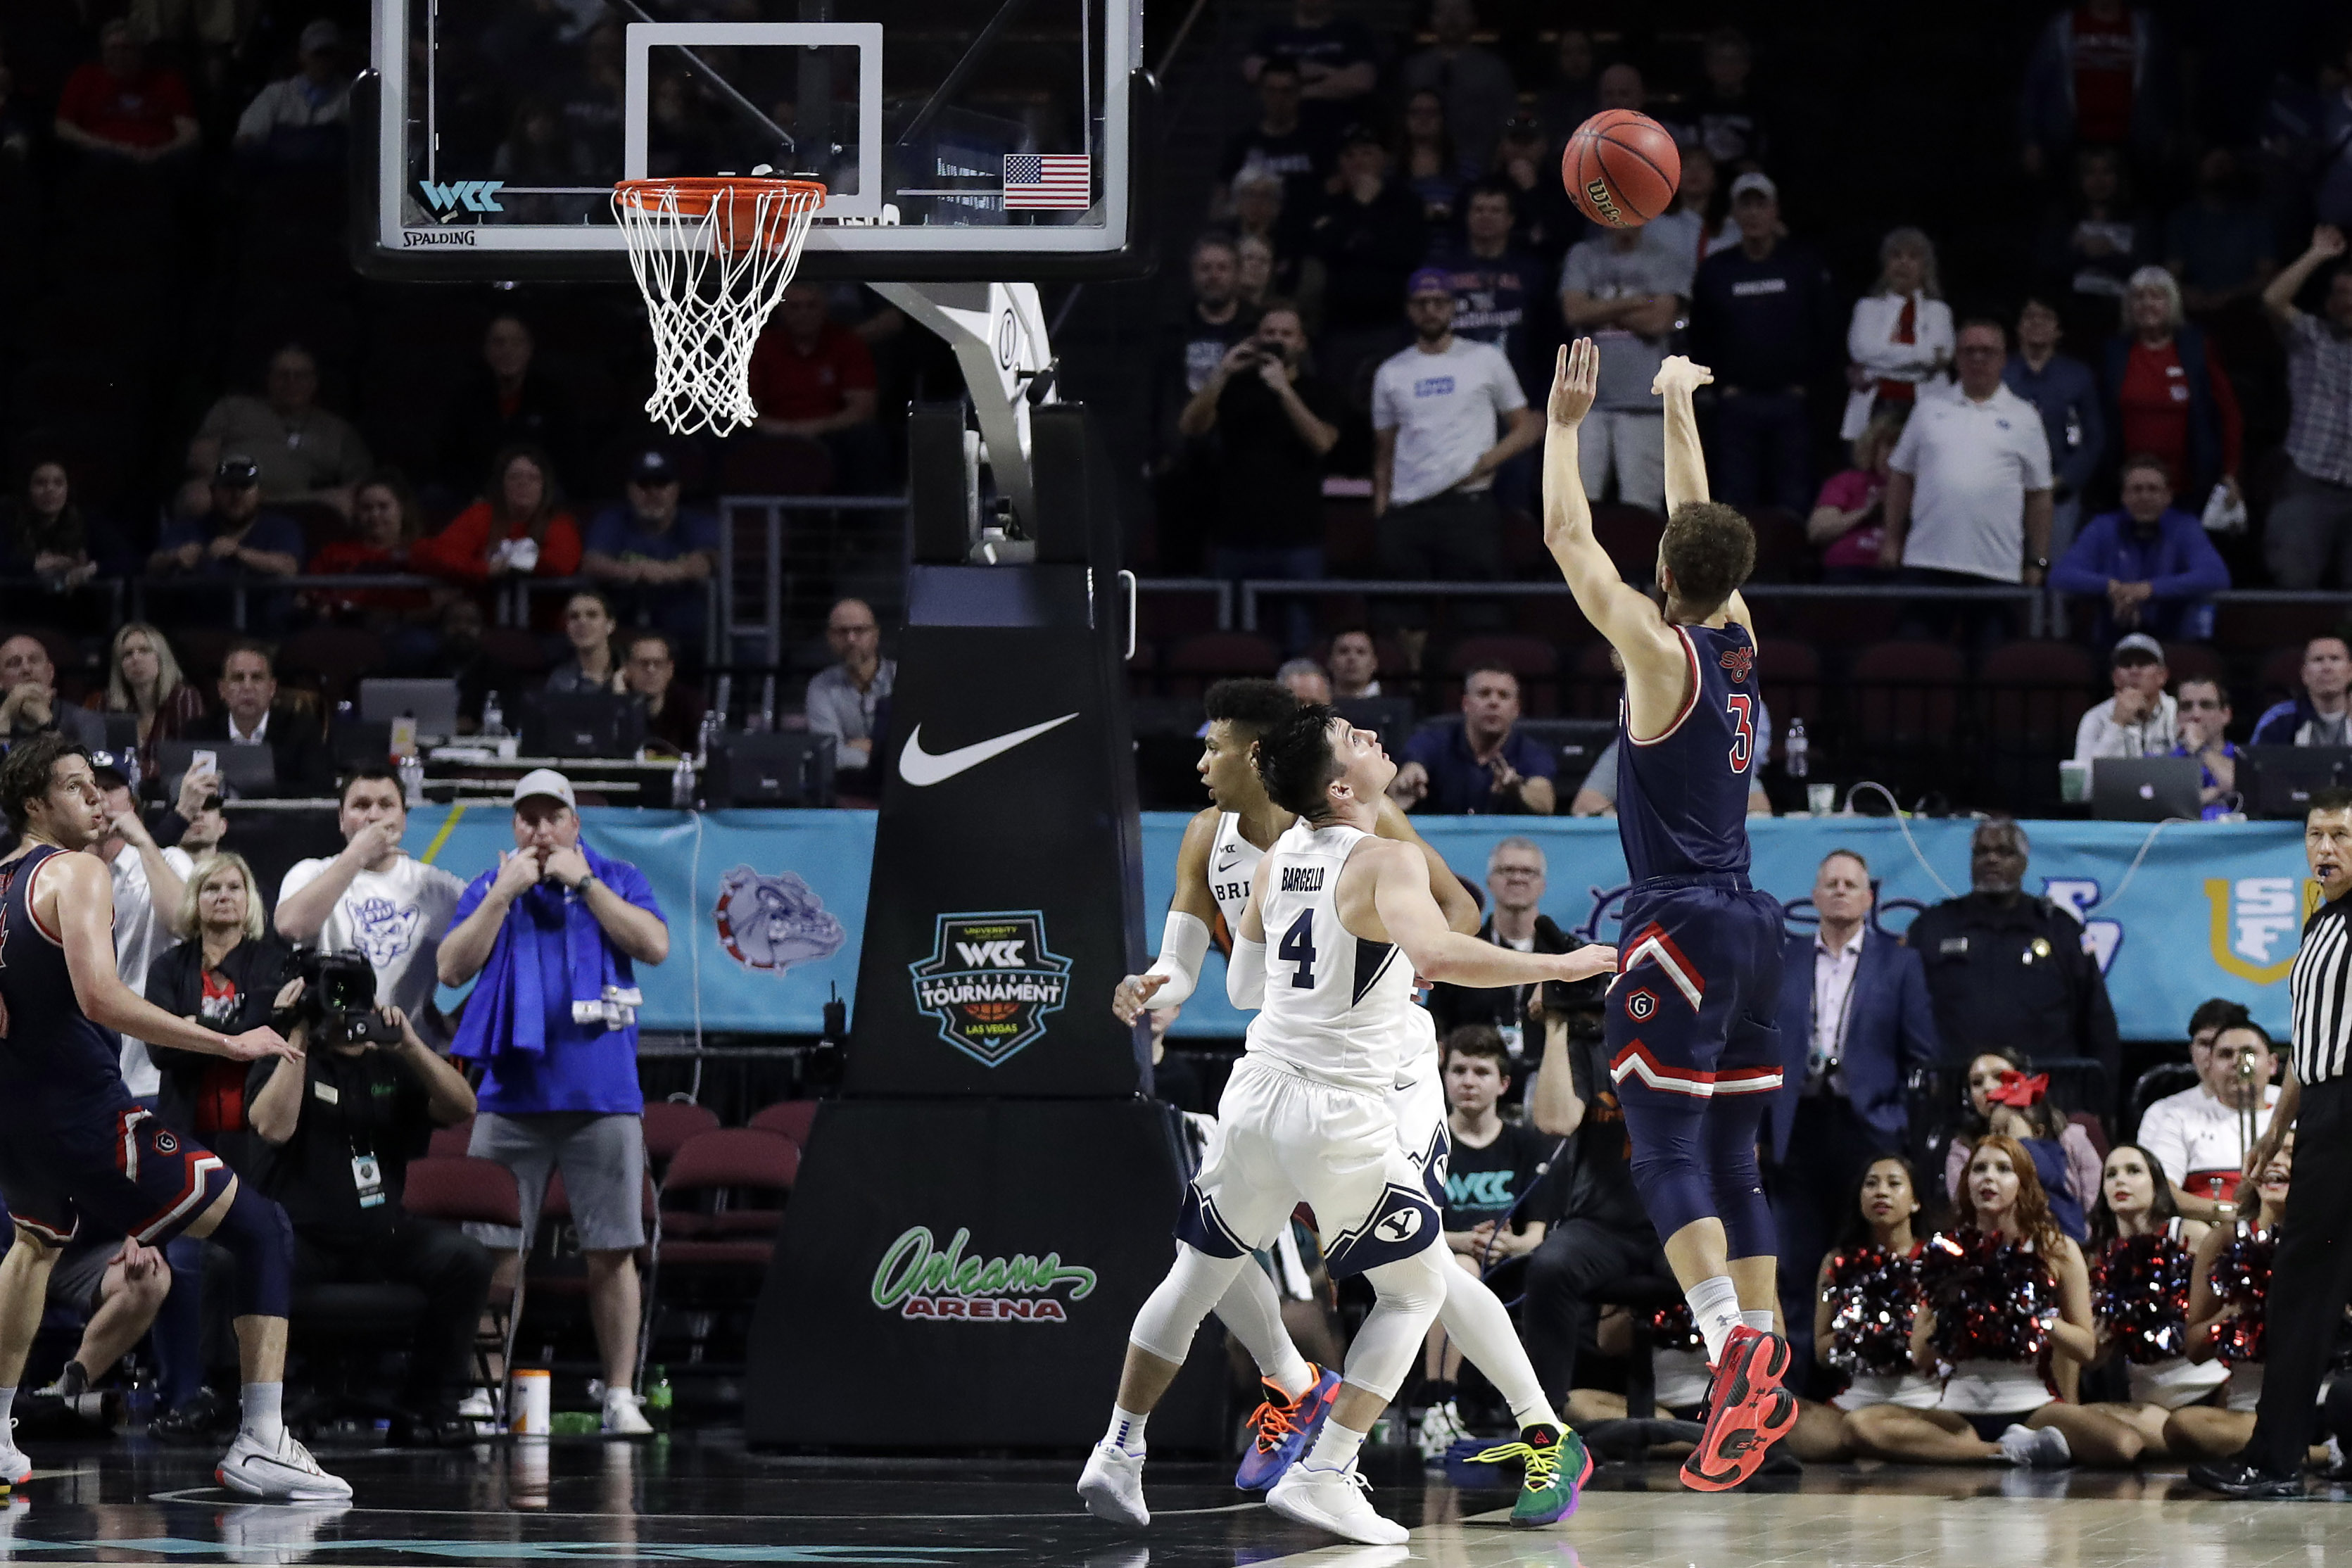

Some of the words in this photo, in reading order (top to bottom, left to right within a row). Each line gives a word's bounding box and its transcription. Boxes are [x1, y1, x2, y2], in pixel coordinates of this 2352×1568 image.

[419, 181, 505, 211] WCC
[403, 230, 475, 247] SPALDING
[1727, 693, 1753, 773] 3
[1220, 844, 1236, 853] WCC
[1281, 867, 1324, 892] BARCELLO
[955, 940, 1026, 968] WCC
[1278, 908, 1316, 990] 4
[921, 974, 1060, 990] BASKETBALL
[921, 983, 1061, 1008] TOURNAMENT
[966, 1025, 985, 1035] LAS
[987, 1023, 1018, 1034] VEGAS
[1444, 1170, 1515, 1203] WCC
[1381, 1210, 1415, 1239] Y
[872, 1225, 1097, 1309] Orleans
[901, 1296, 1068, 1322] ARENA
